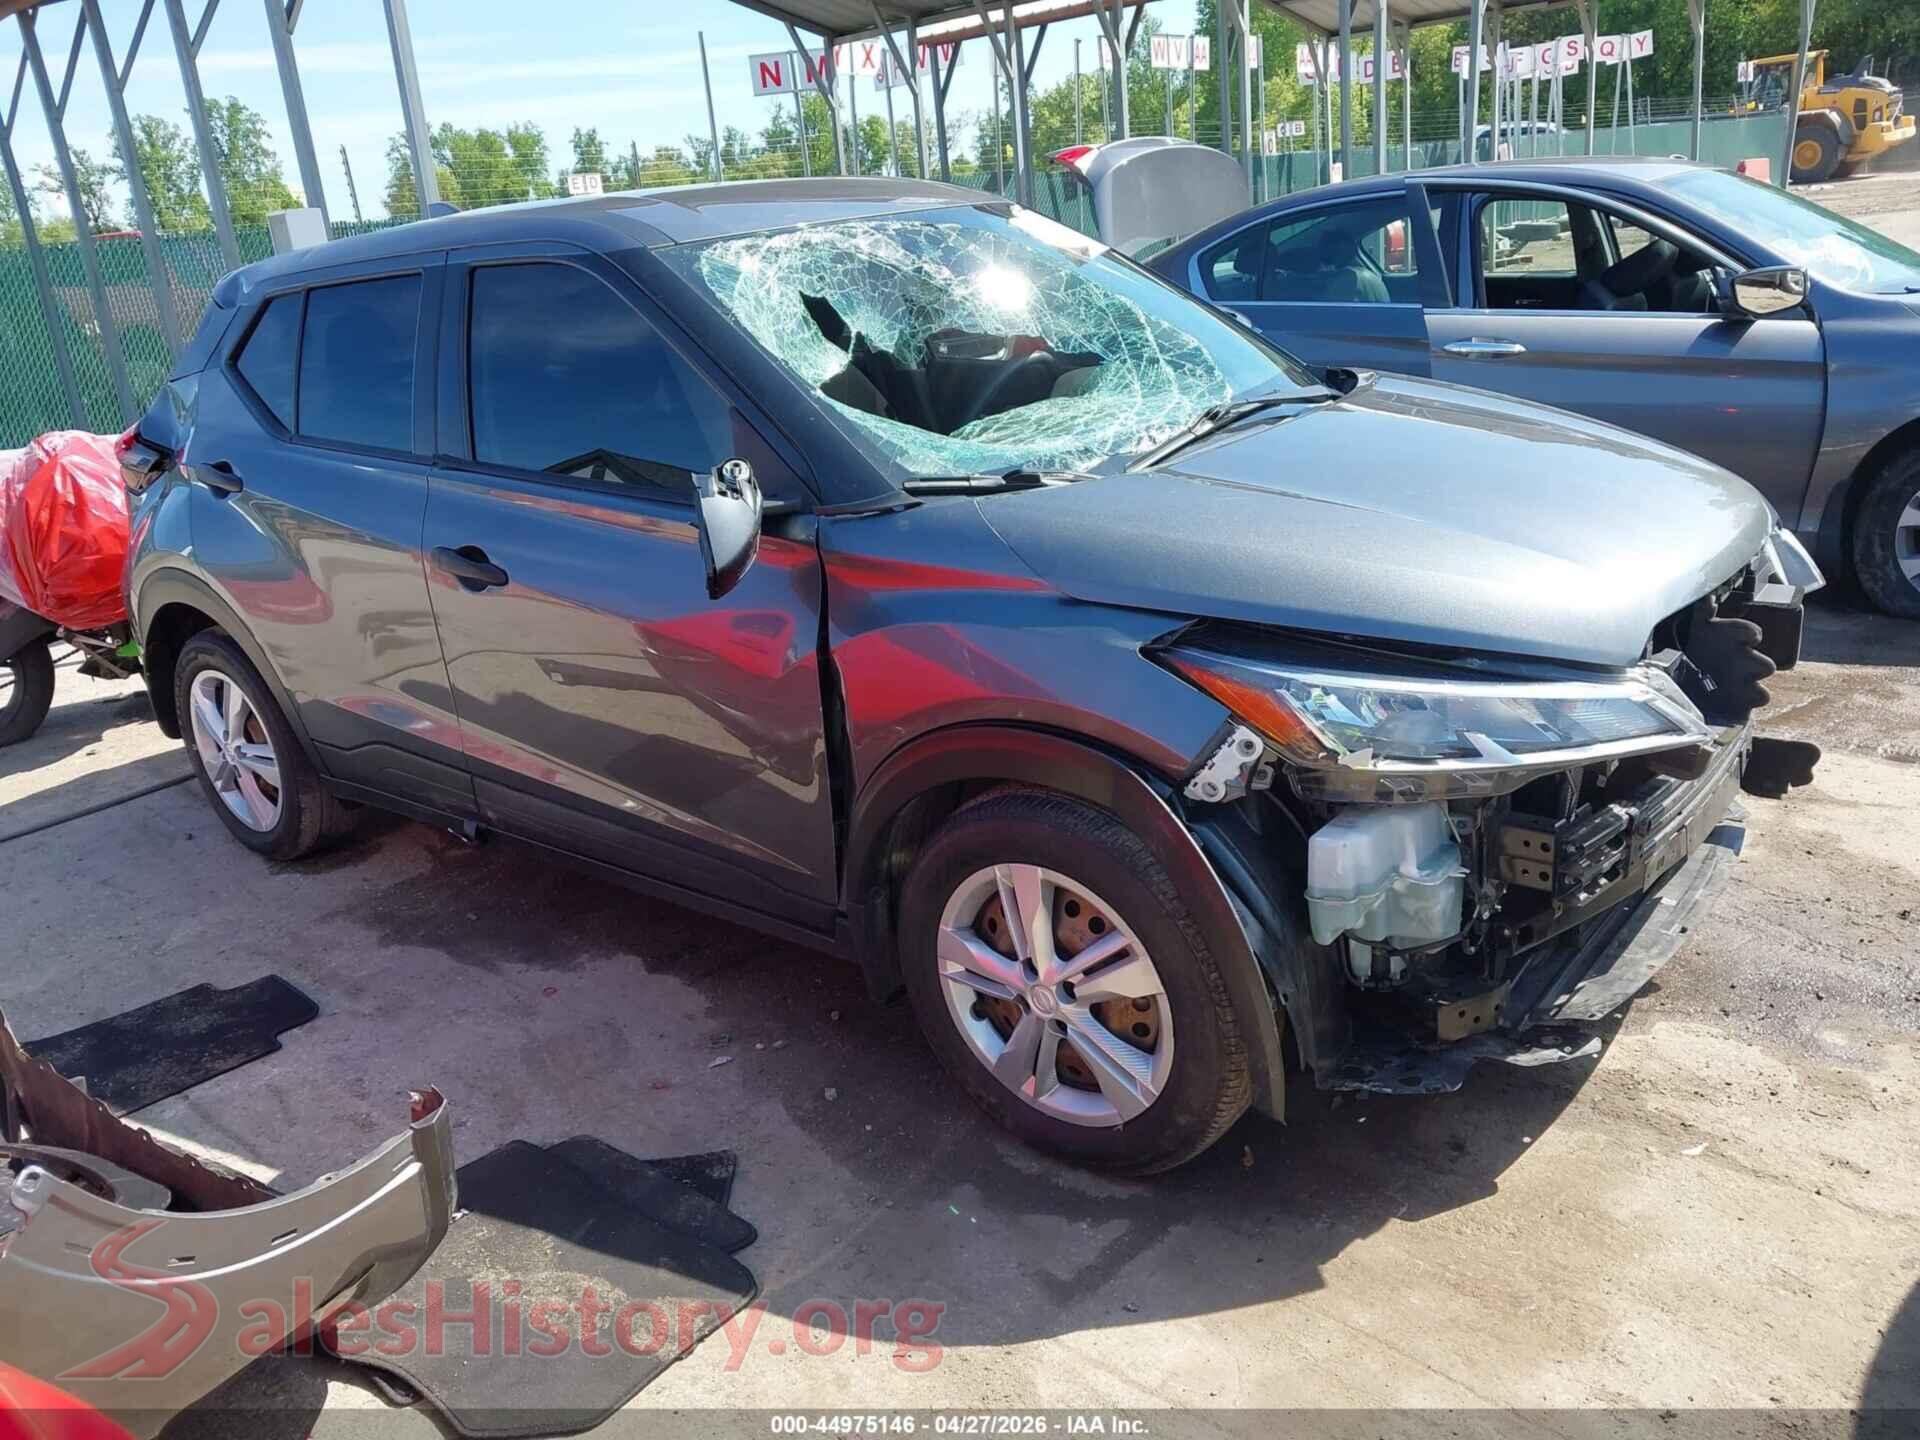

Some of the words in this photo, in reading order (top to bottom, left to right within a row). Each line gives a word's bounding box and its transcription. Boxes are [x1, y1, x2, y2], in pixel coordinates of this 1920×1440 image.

[1152, 40, 1166, 62] W
[1566, 40, 1578, 56] S
[1600, 41, 1616, 57] Q
[1636, 35, 1648, 52] Y
[861, 43, 876, 69] X
[759, 59, 782, 88] N
